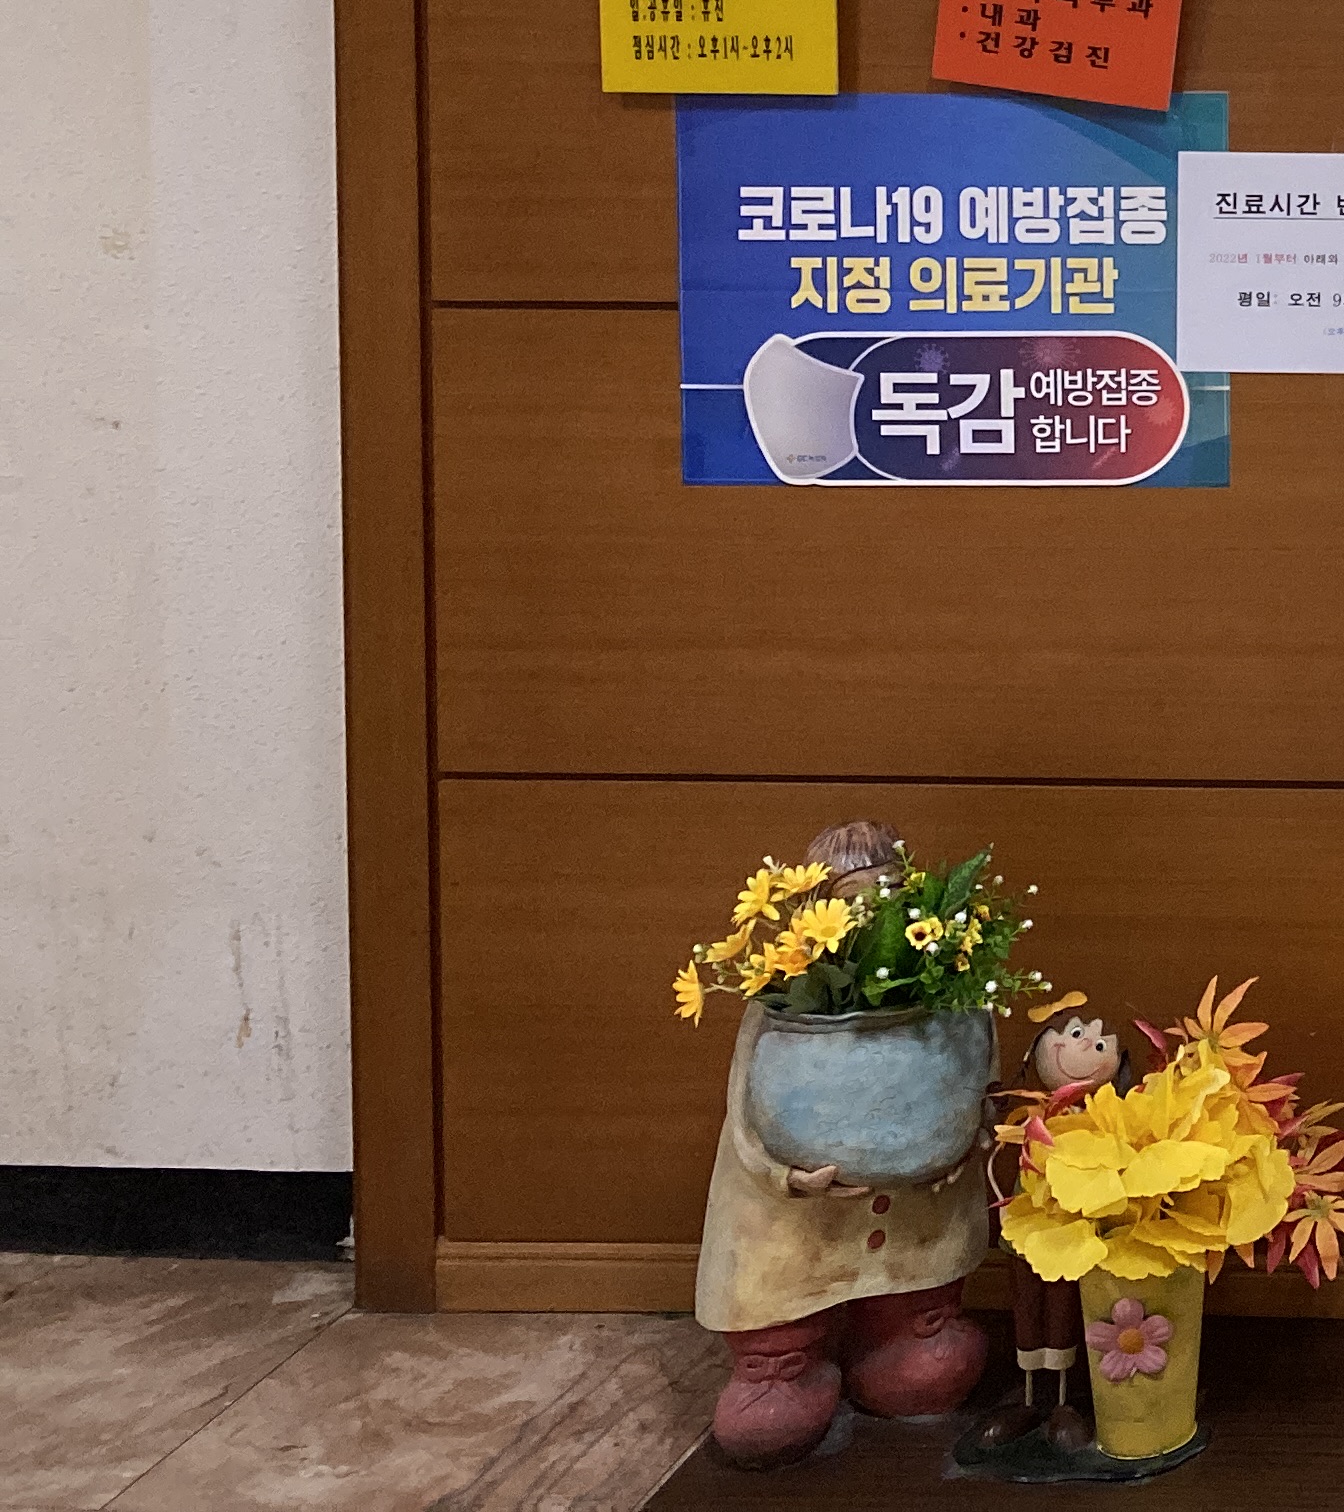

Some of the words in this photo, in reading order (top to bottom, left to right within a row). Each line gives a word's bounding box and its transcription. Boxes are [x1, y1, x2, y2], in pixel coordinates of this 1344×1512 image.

[979, 3, 1041, 31] 내과
[976, 31, 1110, 69] 건강검진
[737, 185, 943, 244] 코로나19
[958, 185, 1169, 245] 예방접종
[1215, 191, 1321, 217] 진료시간
[789, 256, 892, 314] 지정
[908, 256, 1119, 314] 의료기관
[1287, 291, 1322, 308] 오전
[870, 368, 1026, 455] 독감
[1029, 368, 1162, 407] 예방접종
[1029, 414, 1132, 454] 합니다
